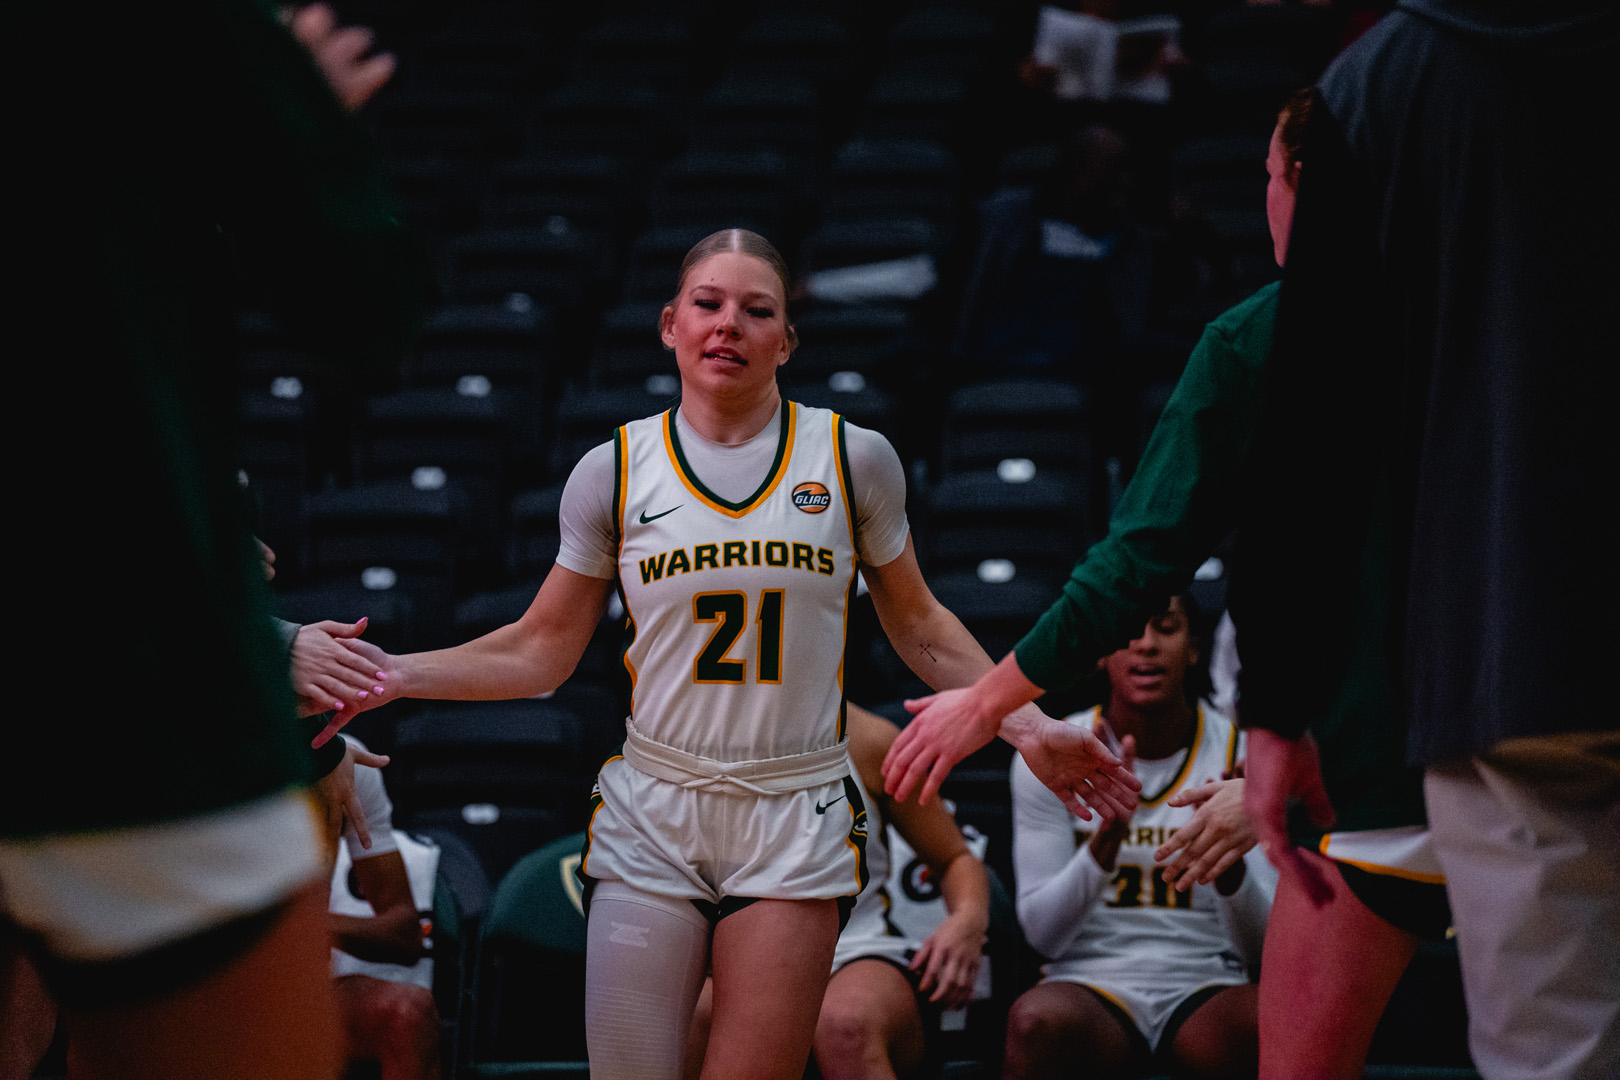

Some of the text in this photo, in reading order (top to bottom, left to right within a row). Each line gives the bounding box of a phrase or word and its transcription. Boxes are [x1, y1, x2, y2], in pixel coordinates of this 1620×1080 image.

[795, 495, 829, 505] GLIAC
[639, 540, 835, 585] WARRIORS
[692, 588, 785, 685] 21
